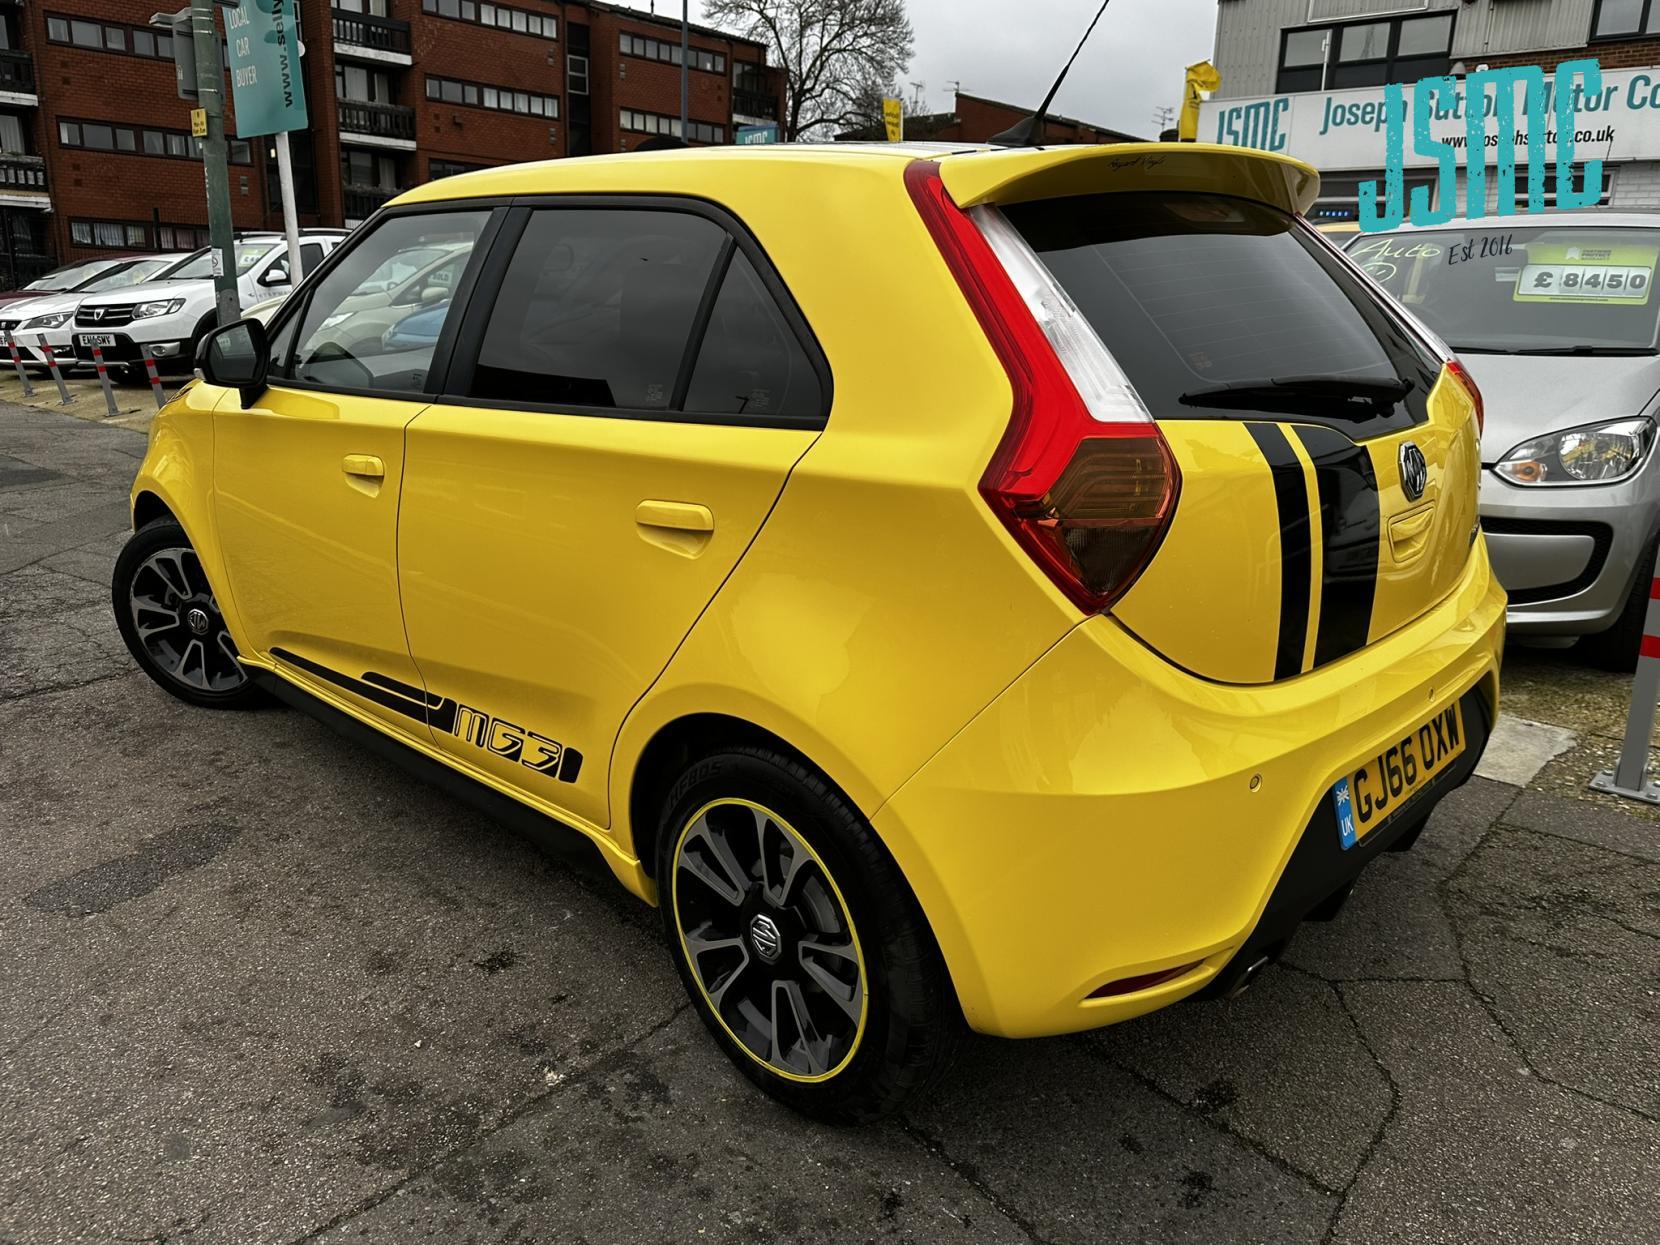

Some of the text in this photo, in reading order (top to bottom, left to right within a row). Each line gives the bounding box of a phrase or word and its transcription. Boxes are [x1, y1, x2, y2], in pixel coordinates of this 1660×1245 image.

[228, 6, 250, 30] LOCAL
[235, 36, 251, 57] CAR
[235, 65, 257, 88] BUYER
[1350, 238, 1441, 259] Auto
[454, 704, 562, 778] MG3
[1354, 703, 1460, 823] GJ66 OXW
[1341, 817, 1354, 837] UK
